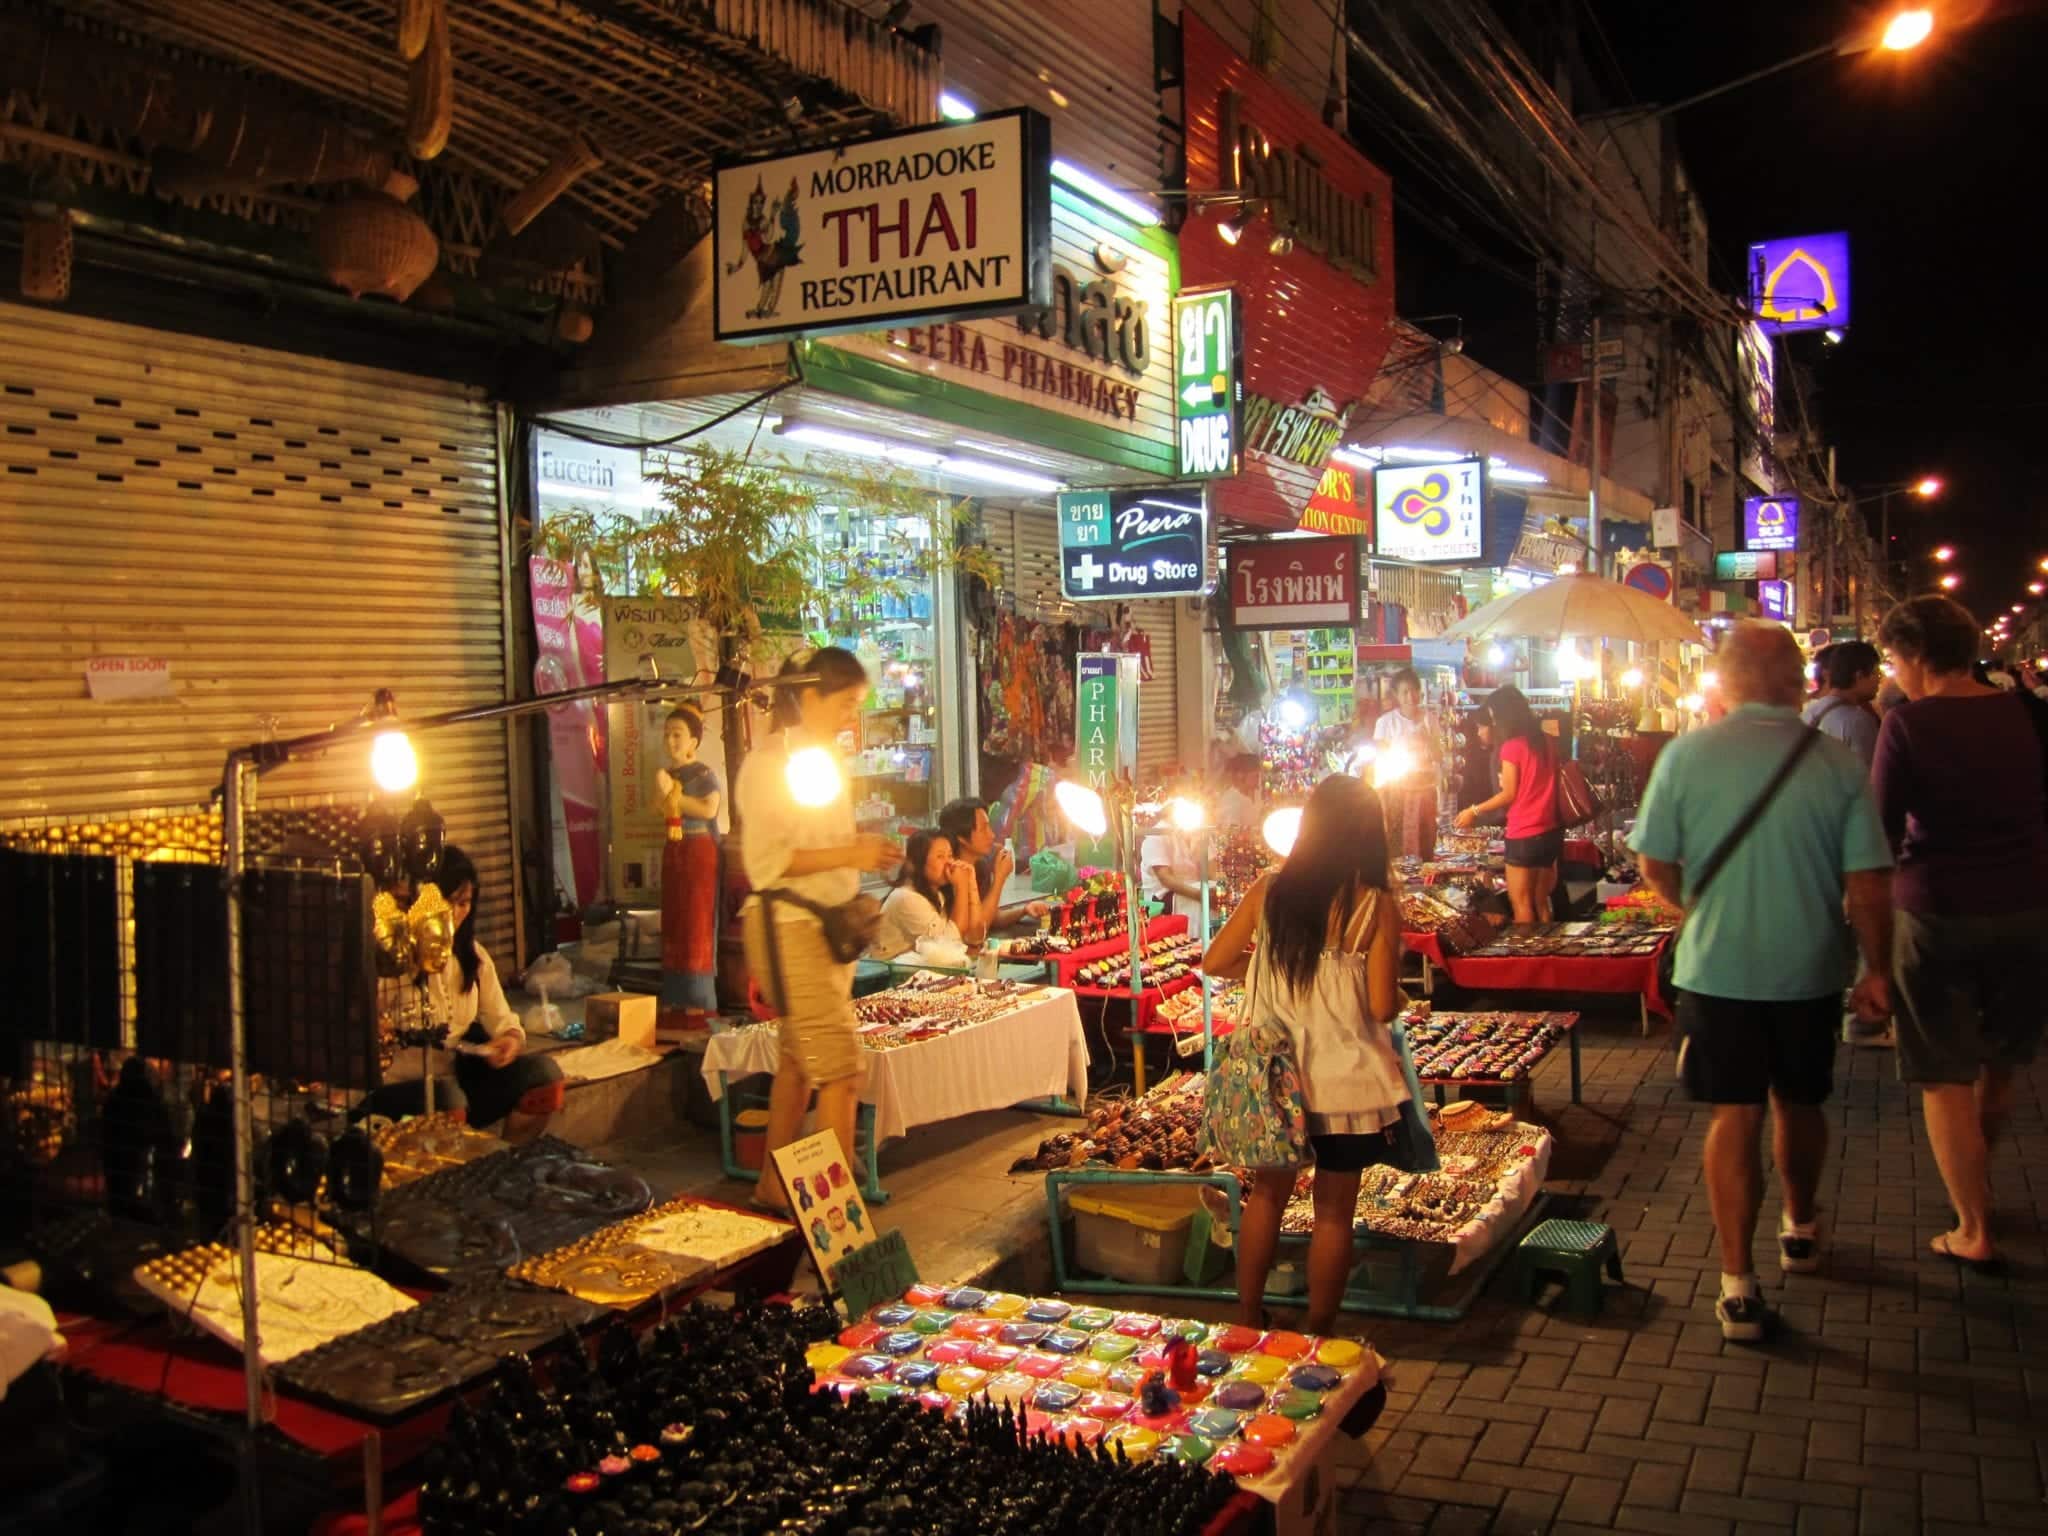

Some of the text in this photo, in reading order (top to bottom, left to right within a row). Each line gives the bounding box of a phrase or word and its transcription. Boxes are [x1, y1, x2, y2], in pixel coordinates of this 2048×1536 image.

[810, 142, 995, 198] MORRADOKE
[822, 187, 977, 268] THAI
[801, 256, 1010, 311] RESTAURANT
[1180, 302, 1227, 376] ยา
[1003, 345, 1139, 422] PHARMACY
[543, 451, 615, 488] Eucerin
[1181, 414, 1230, 474] DRUG
[1070, 503, 1104, 521] ขาย
[1077, 524, 1098, 542] ยา
[1116, 507, 1192, 539] Peera
[1109, 560, 1198, 585] Drug Store
[1237, 553, 1346, 604] โรงพิมพ์
[1089, 682, 1106, 853] PHARMY
